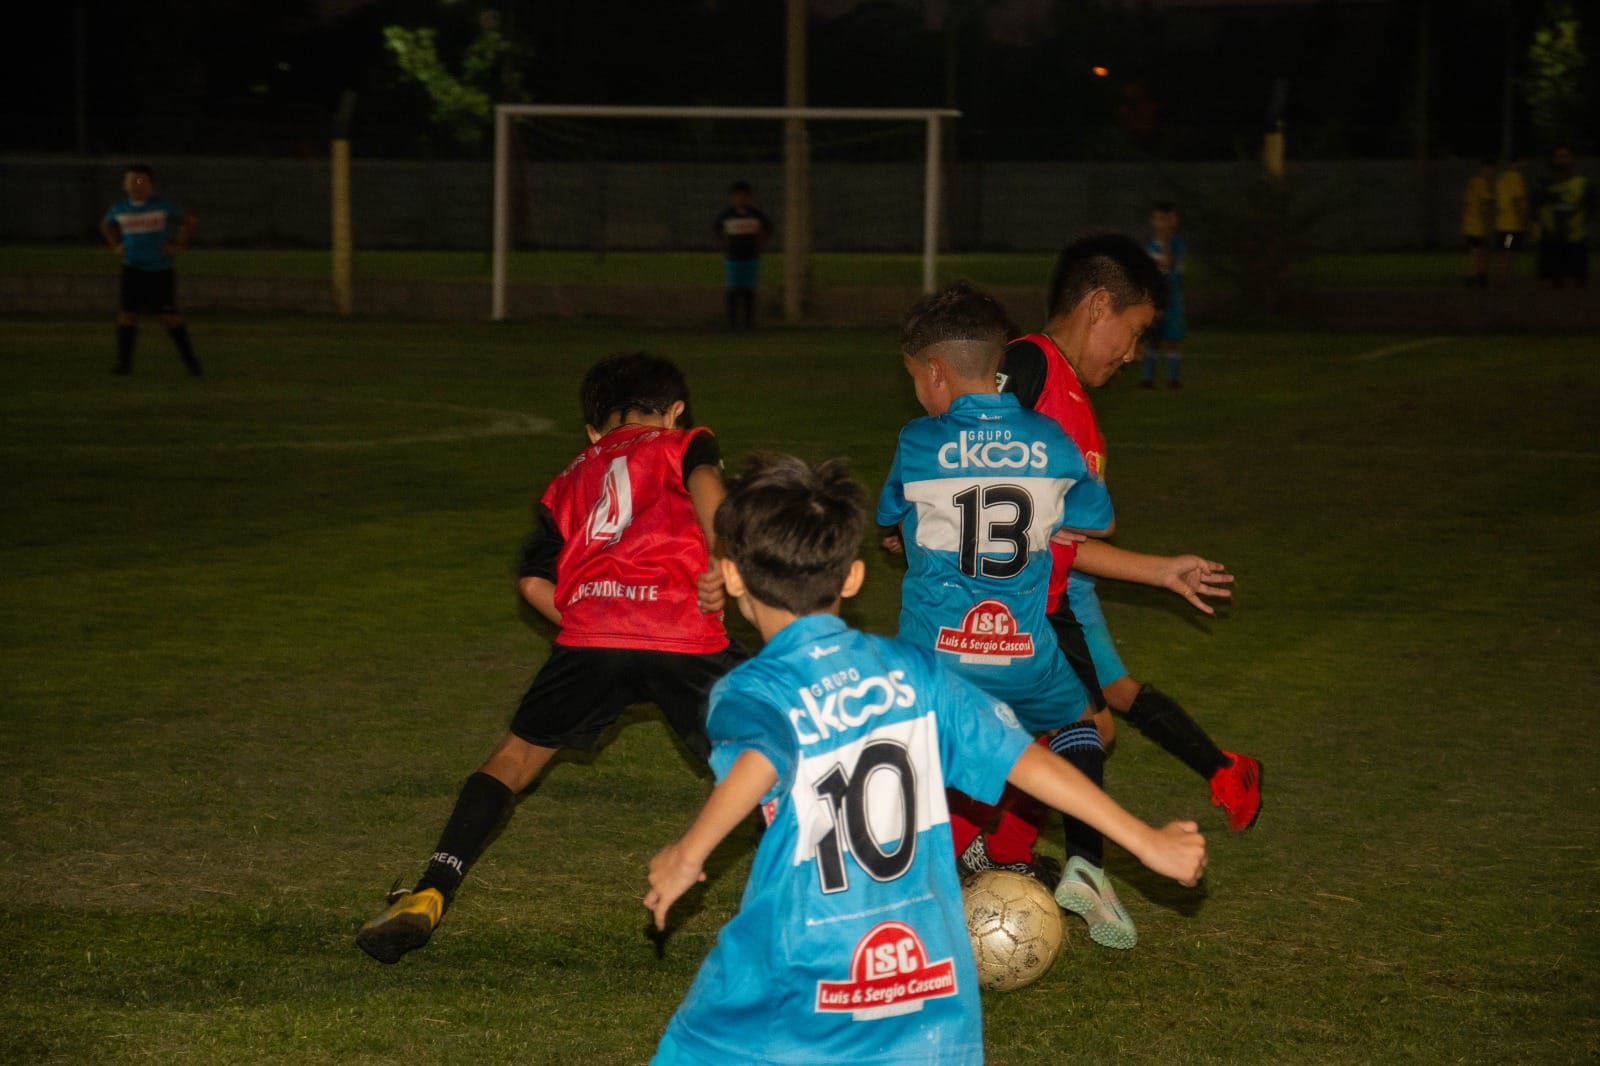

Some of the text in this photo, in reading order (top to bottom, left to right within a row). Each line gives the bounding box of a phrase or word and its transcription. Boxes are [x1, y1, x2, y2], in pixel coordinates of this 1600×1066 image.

[968, 430, 1012, 441] GRUPO
[952, 483, 1035, 580] 13
[971, 612, 1009, 635] LSC
[940, 635, 959, 648] Luis
[960, 638, 968, 648] &
[969, 639, 998, 653] Sergio
[810, 667, 860, 697] GRUPO
[812, 737, 918, 895] 10
[865, 937, 918, 981] LSC
[821, 970, 953, 1005] Luis & Sergio Casconi
